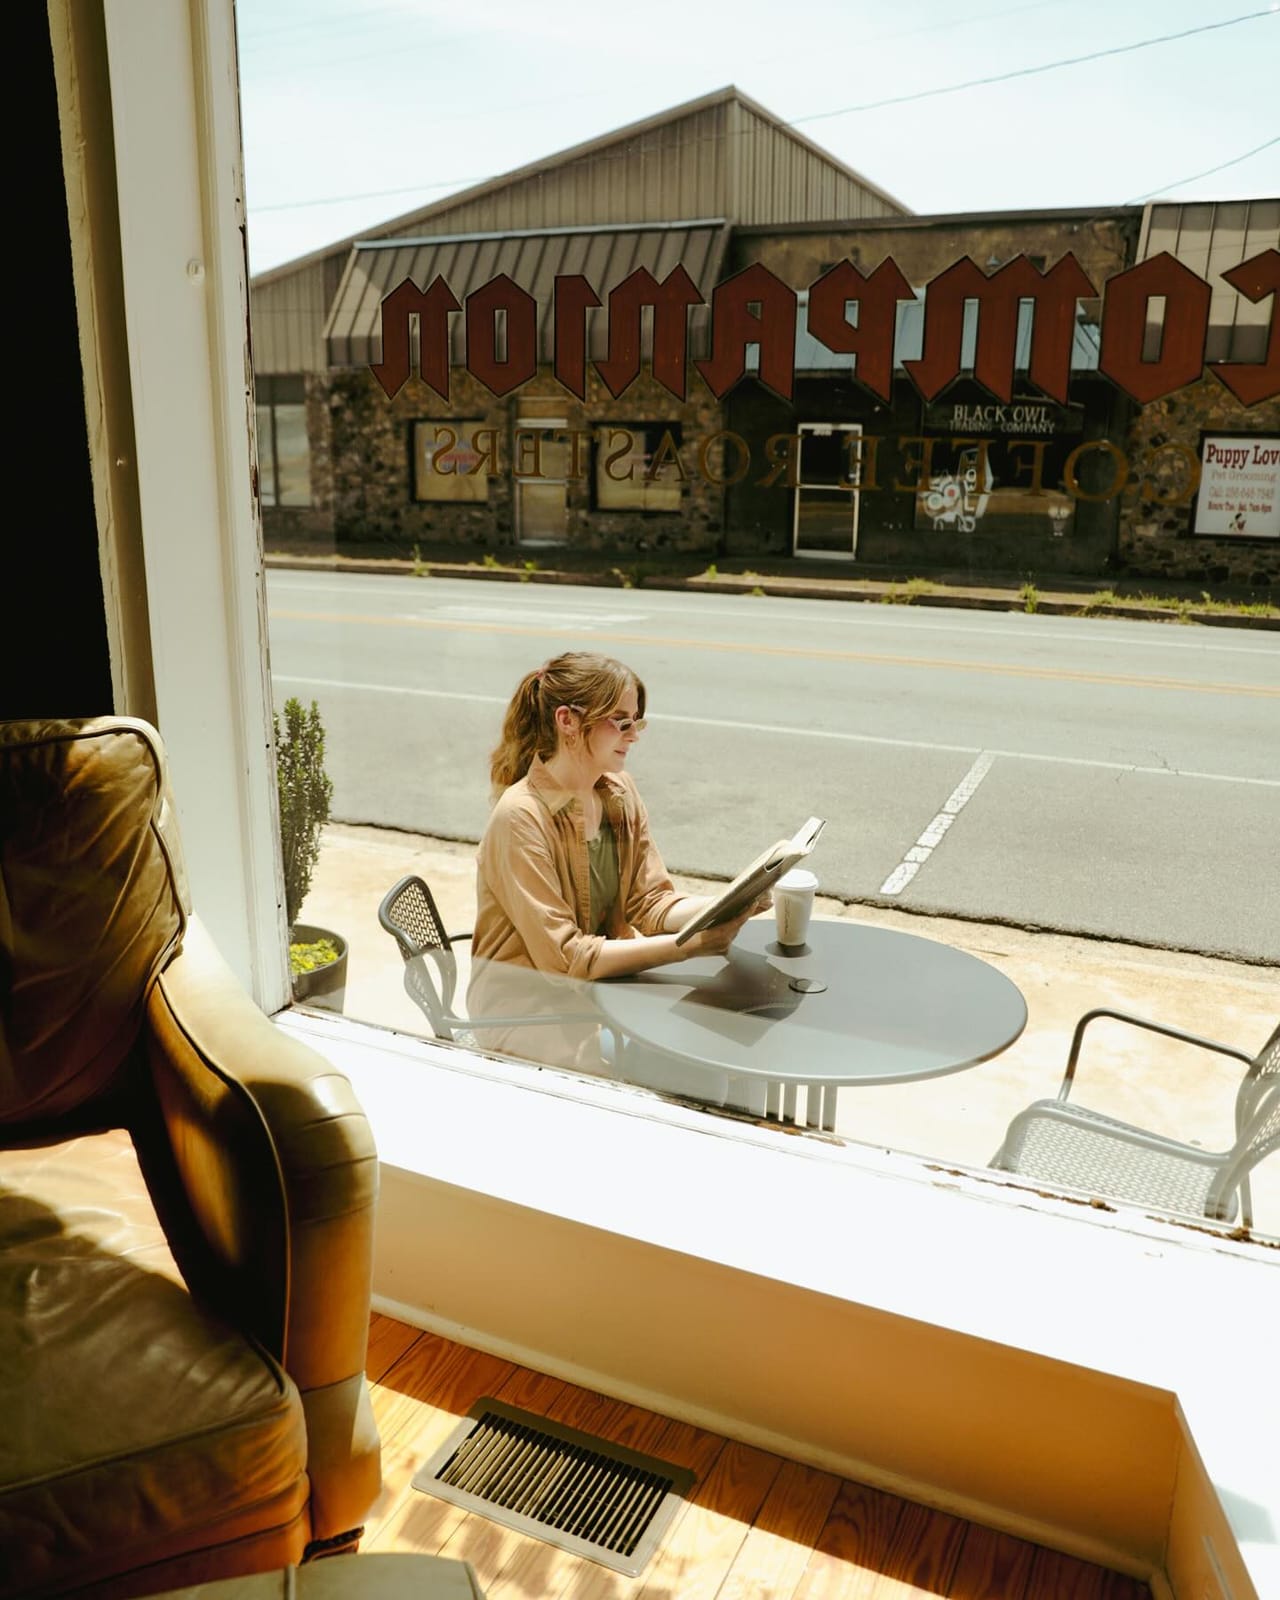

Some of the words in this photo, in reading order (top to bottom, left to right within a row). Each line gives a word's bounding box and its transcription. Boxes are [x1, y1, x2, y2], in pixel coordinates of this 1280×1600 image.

[953, 404, 1008, 423] BLACK
[1012, 405, 1049, 423] OWL
[949, 420, 993, 432] TRADING
[1001, 421, 1055, 434] COMPANY
[1205, 444, 1250, 470] Puppy
[1252, 445, 1280, 465] Lov
